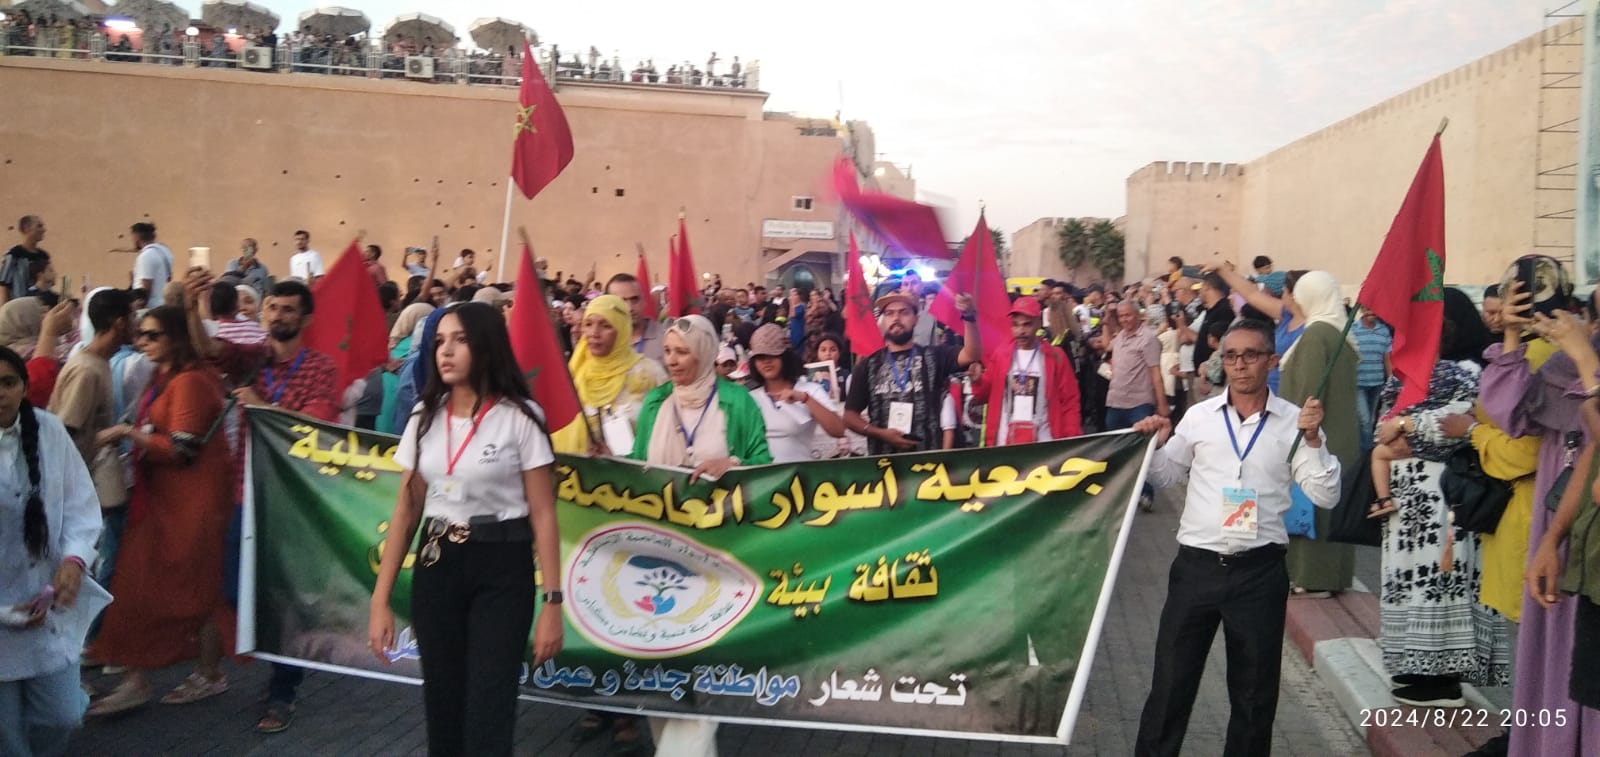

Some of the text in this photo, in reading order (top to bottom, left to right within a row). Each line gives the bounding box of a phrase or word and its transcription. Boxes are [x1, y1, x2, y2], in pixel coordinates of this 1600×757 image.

[555, 465, 744, 529] العاصمة
[754, 458, 898, 529] أسوار
[911, 457, 1108, 512] جمعية
[767, 561, 832, 618] بيئة
[849, 549, 938, 602] ثقافة
[533, 658, 597, 690] عمل
[594, 668, 620, 696] و
[623, 659, 691, 700] جادة
[692, 663, 800, 707] مواطنة
[808, 668, 882, 707] شعار
[890, 672, 967, 706] تحت
